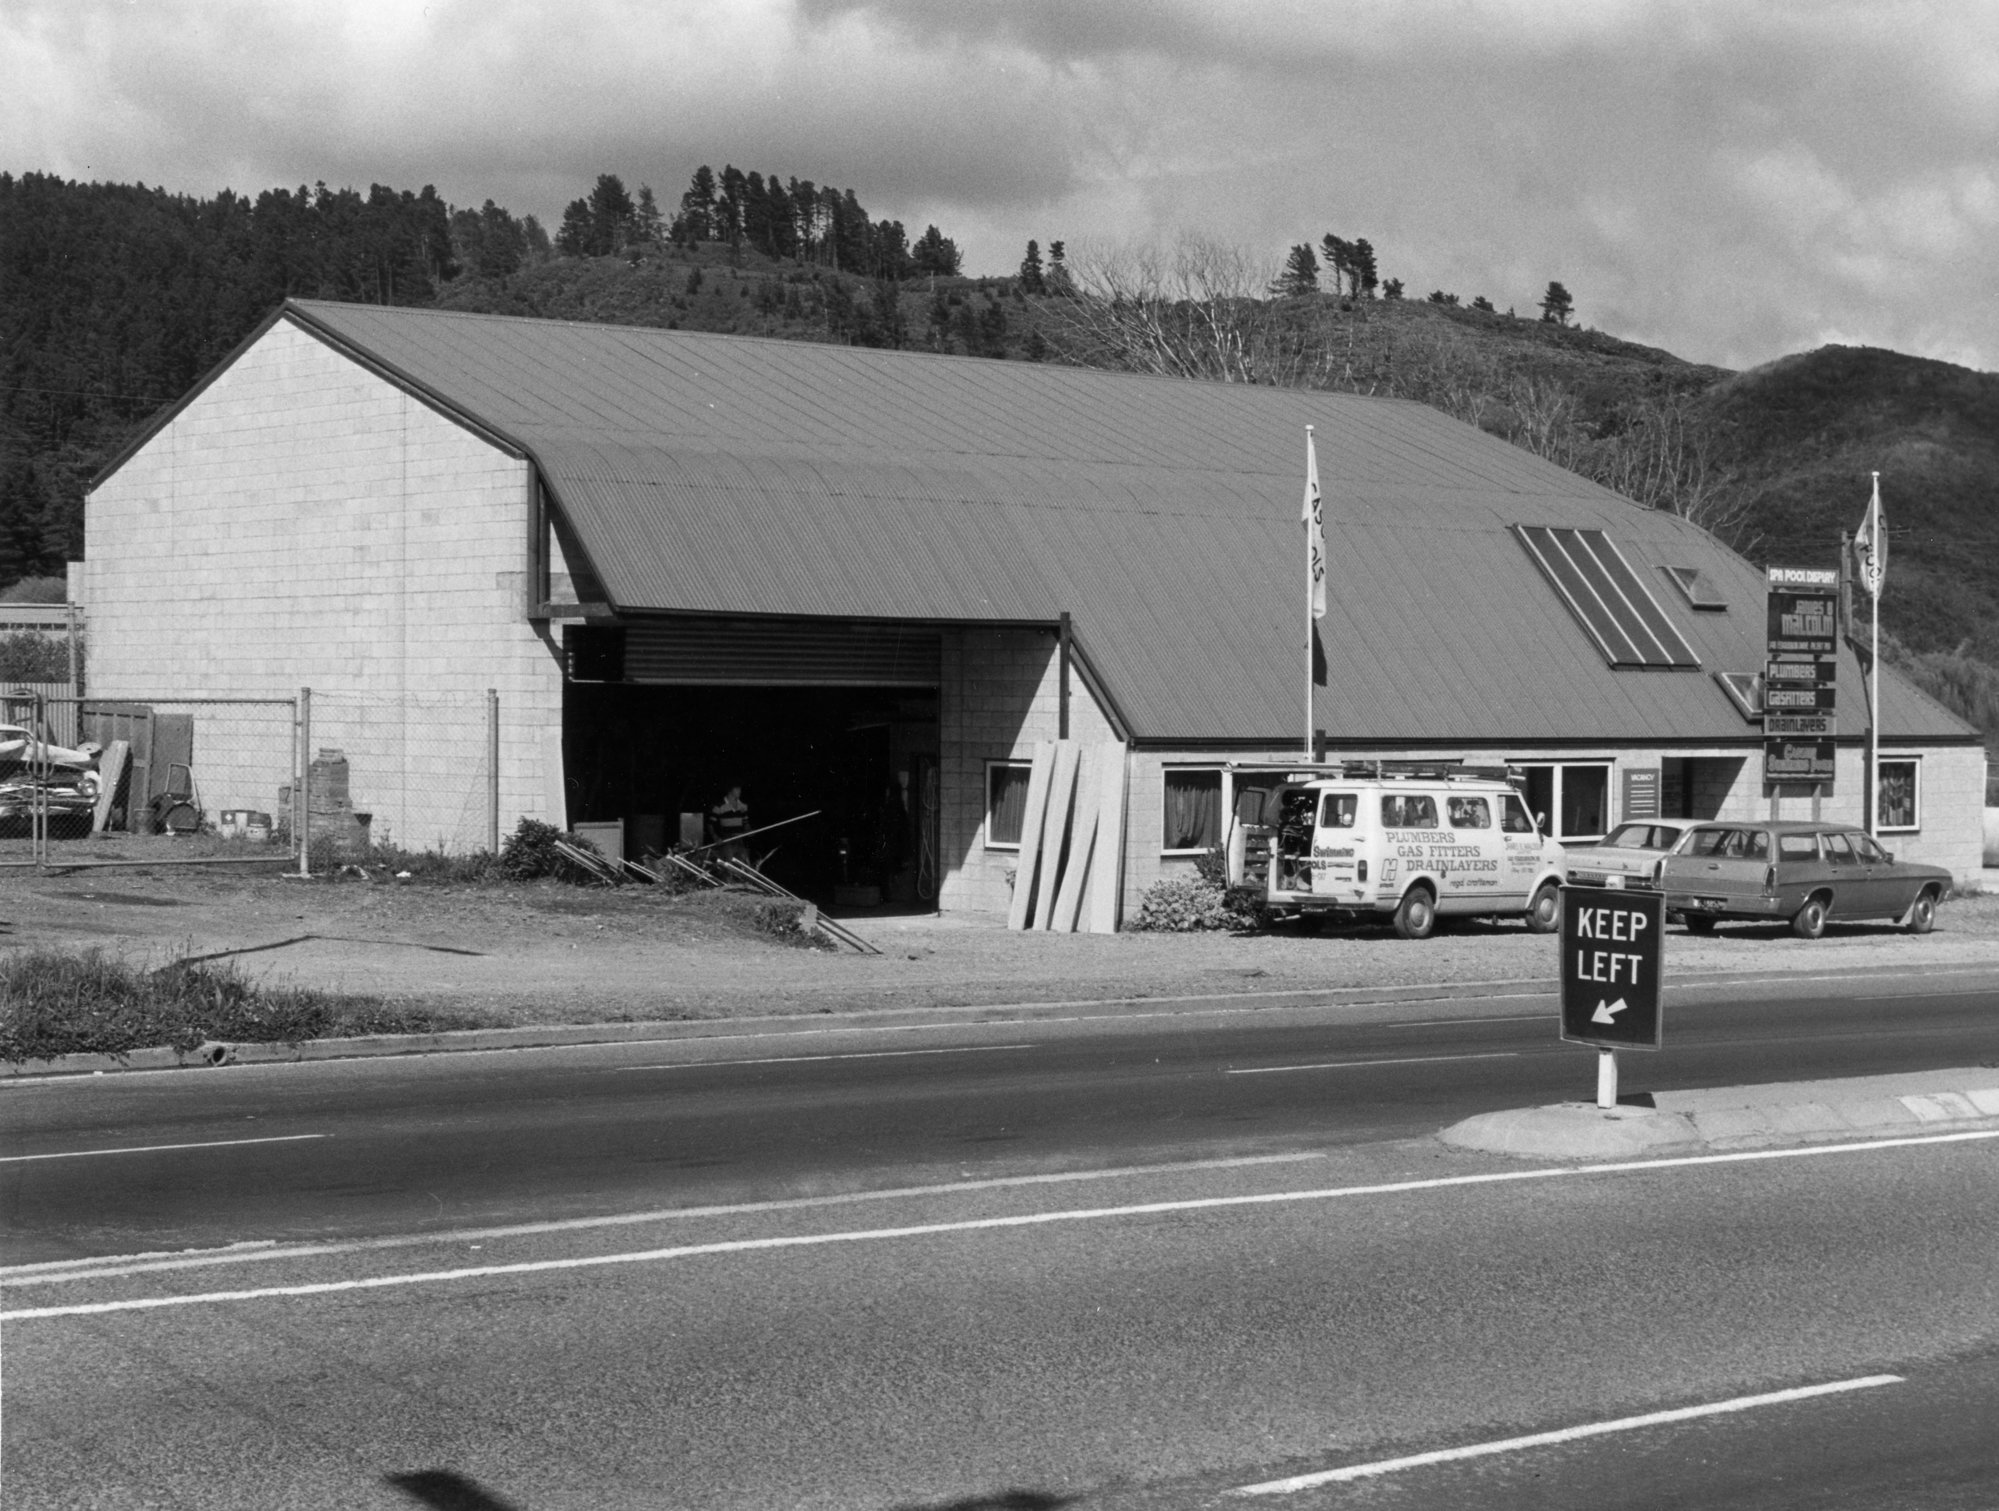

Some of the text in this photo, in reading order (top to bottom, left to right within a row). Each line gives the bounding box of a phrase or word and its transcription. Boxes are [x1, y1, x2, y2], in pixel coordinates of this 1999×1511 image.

[1785, 569, 1806, 583] POOL
[1807, 570, 1836, 584] DISPLAY
[1386, 832, 1456, 844] PLUMBERS
[1397, 845, 1481, 857] GAS FITTERS
[1406, 860, 1498, 872] DRAINLAYERS
[1577, 907, 1648, 942] KEEP
[1577, 950, 1643, 985] LEFT
